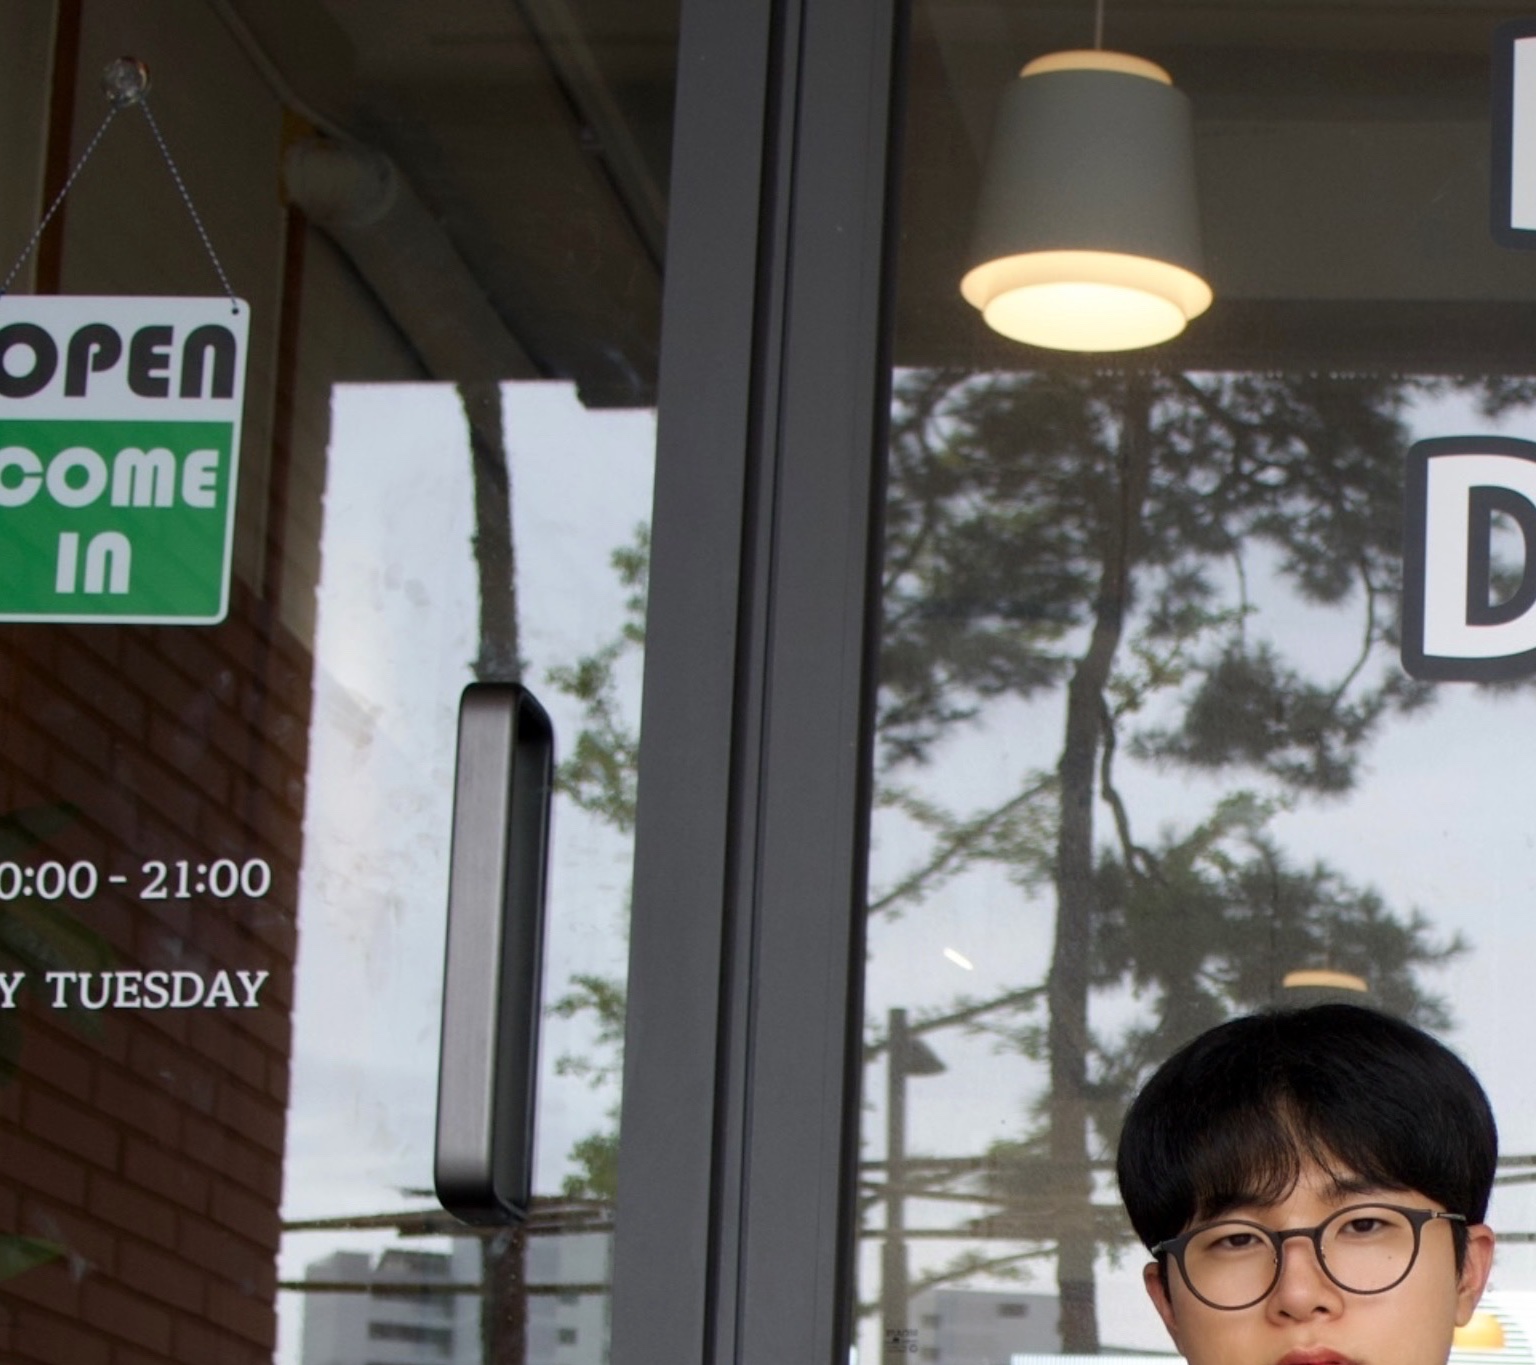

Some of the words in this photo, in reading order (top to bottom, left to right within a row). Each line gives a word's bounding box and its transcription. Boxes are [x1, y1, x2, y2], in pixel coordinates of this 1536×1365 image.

[0, 322, 237, 399] OPEN
[0, 446, 219, 508] COME
[55, 531, 132, 594] IN
[140, 858, 271, 899] 21:00
[46, 970, 269, 1009] TUESDAY
